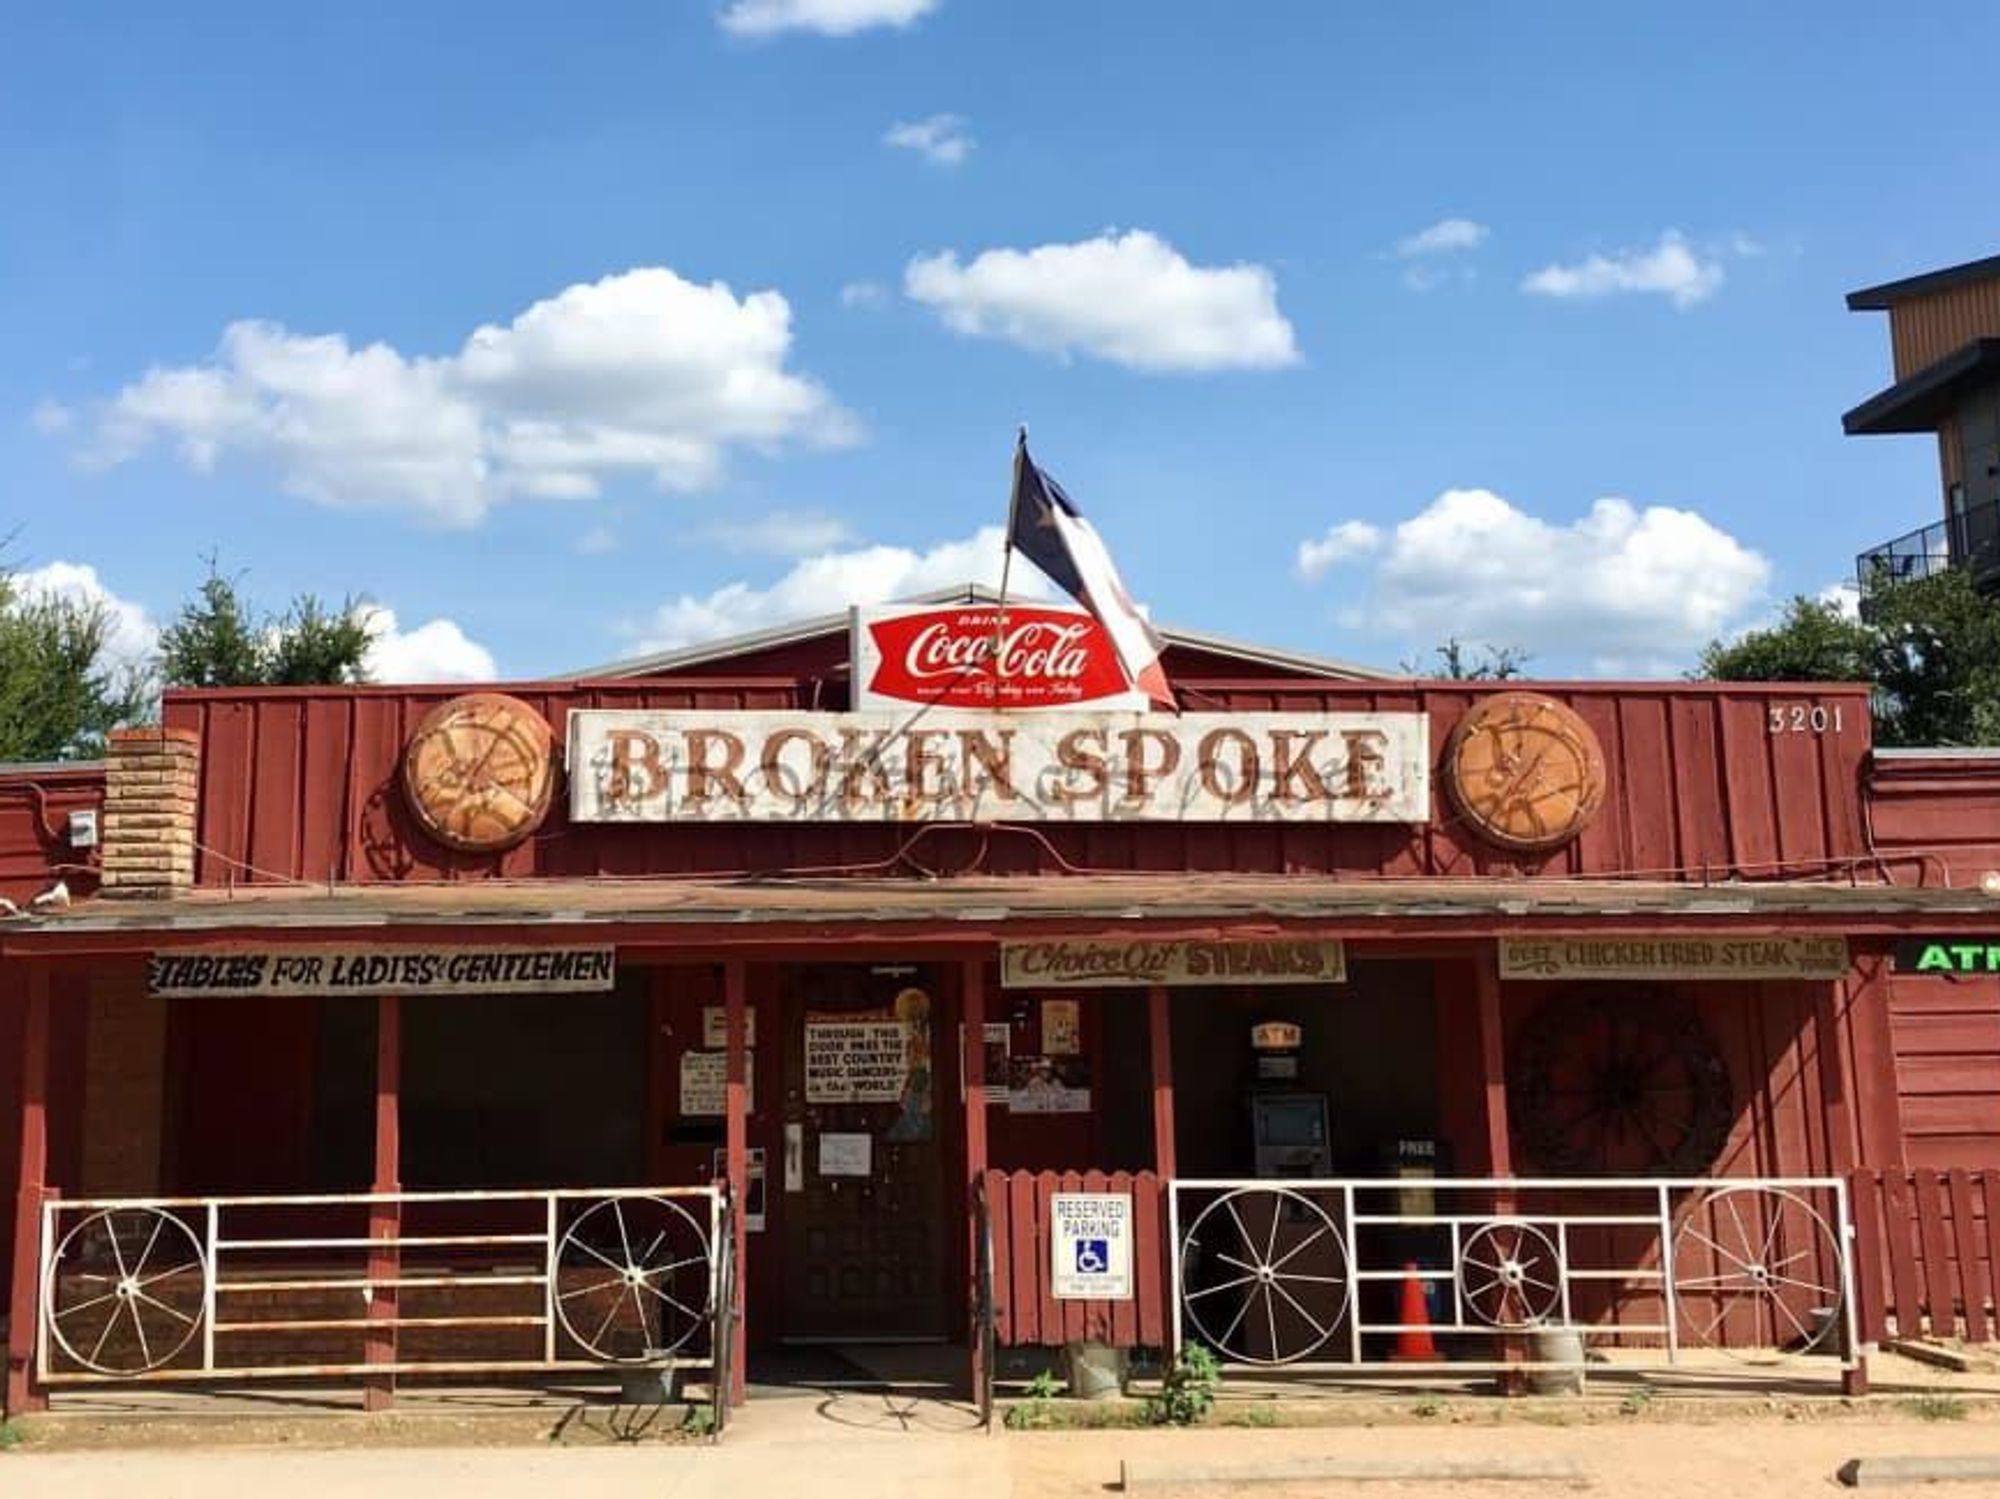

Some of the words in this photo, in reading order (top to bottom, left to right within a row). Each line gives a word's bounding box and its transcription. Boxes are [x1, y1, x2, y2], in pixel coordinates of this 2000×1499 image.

[1769, 706, 1842, 733] 3201
[604, 728, 1019, 803] BROKEN
[1053, 726, 1394, 803] SPOKE
[1021, 941, 1121, 974] Choice
[1122, 940, 1178, 976] Cut
[1184, 940, 1325, 976] STEAKS
[1565, 941, 1656, 965] CHICKEN
[1659, 941, 1713, 965] FRIED
[1721, 941, 1794, 966] STEAK
[156, 954, 269, 988] TABLES
[270, 956, 323, 986] FOR
[329, 954, 439, 985] LADIES
[448, 951, 612, 984] GENTLEMEN
[810, 1028, 865, 1039] THROUGH
[873, 1028, 899, 1039] THIS
[1257, 1027, 1297, 1042] ATM
[809, 1053, 838, 1065] BEST
[842, 1052, 901, 1064] COUNTRY
[808, 1066, 844, 1078] MUSIC
[1398, 1140, 1435, 1157] FREE
[1057, 1200, 1124, 1219] RESERVED
[1063, 1219, 1120, 1238] PARKING
